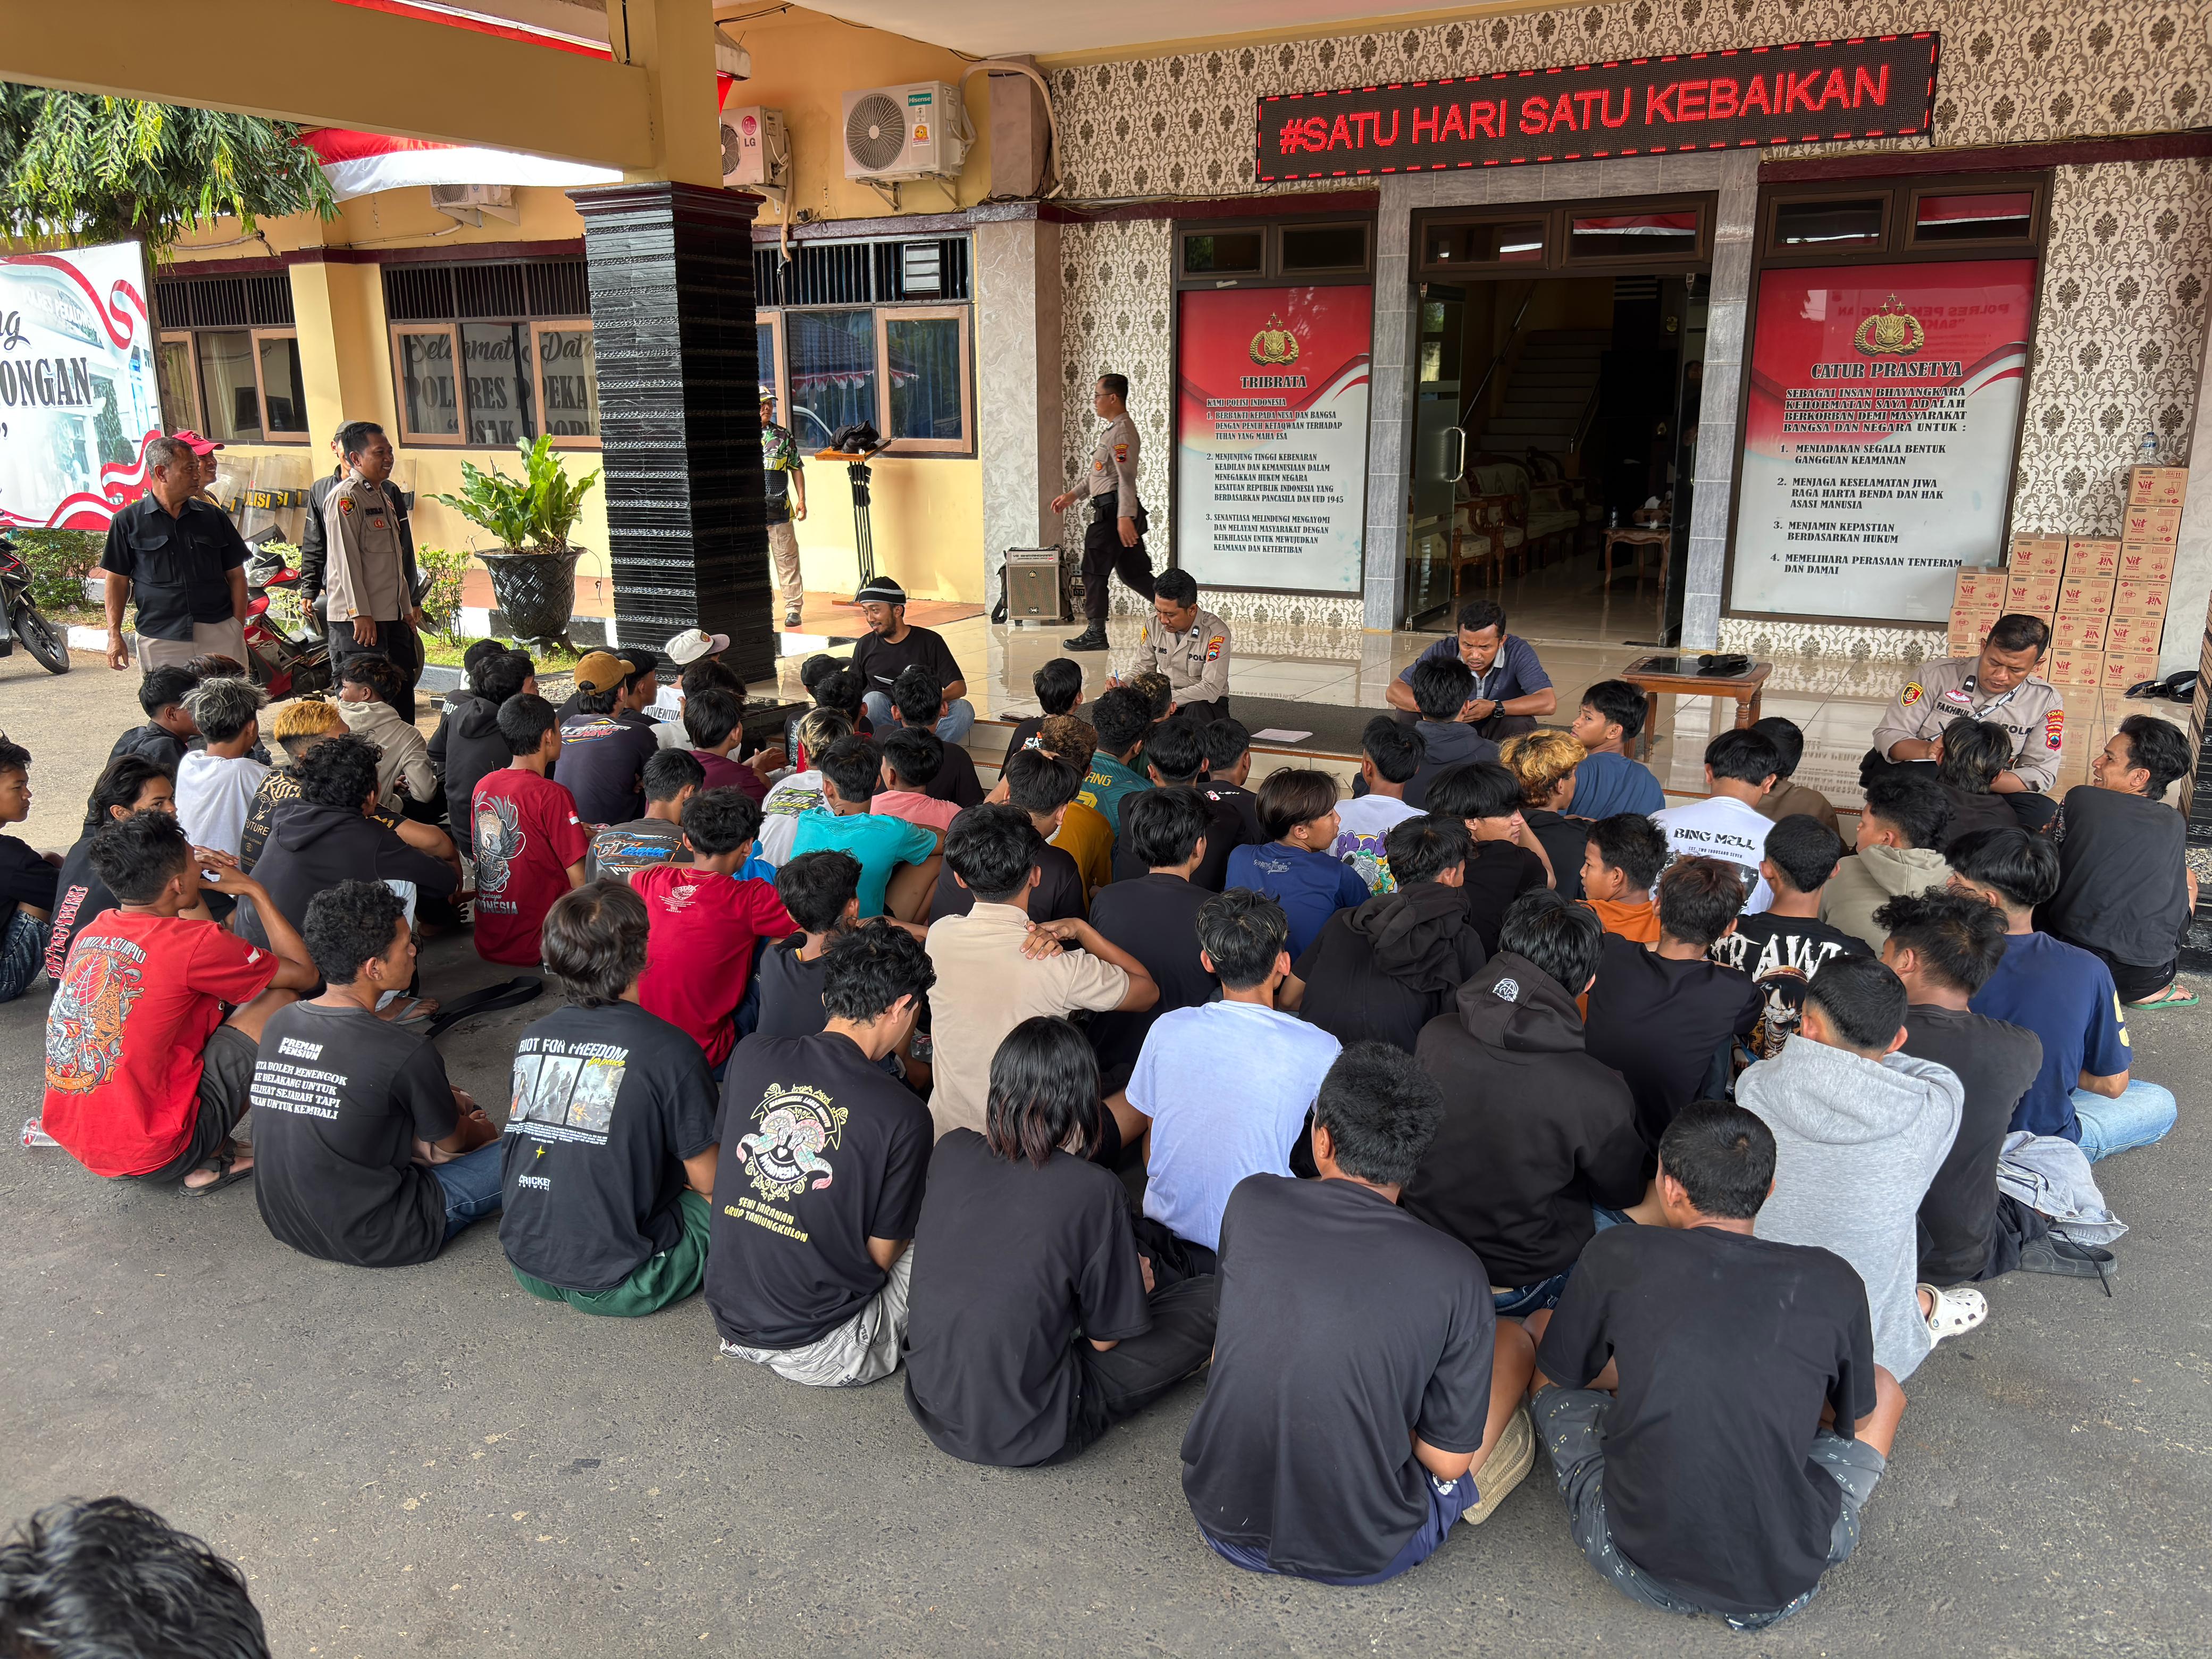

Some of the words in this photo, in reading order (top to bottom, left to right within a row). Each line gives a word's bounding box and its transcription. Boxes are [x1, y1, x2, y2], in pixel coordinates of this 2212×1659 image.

[1279, 107, 1399, 154] #SATU
[1411, 98, 1508, 145] HARI
[1519, 87, 1631, 135] SATU
[1644, 63, 1889, 126] KEBAIKAN
[744, 138, 756, 147] LG
[1811, 364, 1866, 379] CATUR
[1870, 361, 1963, 378] PRASETYA
[1241, 376, 1307, 388] TRIBRATA
[1786, 389, 1836, 398] SEBAGAI
[1838, 389, 1872, 397] INSAN
[1875, 388, 1966, 397] BHAYANGKARA
[1785, 399, 1872, 409] KEHORMATAN
[1876, 399, 1906, 409] SAYA
[1910, 399, 1966, 409] ADALAH
[1784, 411, 1855, 421] BERKORBAN
[1858, 411, 1887, 421] DEMI
[1890, 411, 1967, 421] MASYARAKAT
[1782, 423, 1830, 432] BANGSA
[1833, 423, 1858, 432] DAN
[1862, 423, 1913, 432] NEGARA
[1916, 422, 1957, 432] UNTUK
[1780, 445, 1789, 454] 1.
[1796, 445, 1861, 454] MENIADAKAN
[1863, 445, 1901, 454] SEGALA
[1904, 445, 1946, 454] BENTUK
[1795, 456, 1848, 465] GANGGUAN
[1851, 456, 1906, 465] KEAMANAN
[1777, 477, 1787, 487] 2.
[1792, 477, 1837, 487] MENJAGA
[1839, 478, 1909, 488] KESELAMATAN
[1912, 479, 1937, 488] JIWA
[2138, 480, 2154, 489] Vit
[1791, 489, 1820, 498] RAGA
[1822, 489, 1856, 499] HARTA
[1859, 489, 1894, 499] BENDA
[1896, 490, 1918, 499] DAN
[1921, 490, 1944, 500] HAK
[1790, 499, 1818, 509] ASASI
[1820, 500, 1863, 509] MANUSIA
[1773, 521, 1782, 530] 3.
[1788, 522, 1836, 531] MENJAMIN
[1839, 522, 1895, 532] KEPASTIAN
[2131, 518, 2147, 527] Vit
[1787, 532, 1859, 543] BERDASARKAN
[1863, 533, 1899, 543] HUKUM
[1262, 545, 1302, 554] KETERTIBAN
[2017, 551, 2033, 560] Vit
[2126, 556, 2142, 565] Vit
[1770, 554, 1779, 563] 4.
[1785, 554, 1848, 565] MEMELIHARA
[1851, 556, 1905, 566] PERASAAN
[1907, 558, 1962, 568] TENTERAM
[2097, 557, 2113, 566] Vit
[1784, 564, 1804, 574] DAN
[1807, 564, 1839, 575] DAMAI
[1961, 585, 1976, 594] Vit
[2066, 589, 2082, 598] Vit
[2146, 596, 2161, 606] Vit
[2114, 628, 2129, 638] Vit
[2056, 660, 2072, 670] Vit
[1674, 828, 1711, 841] BING
[1714, 834, 1755, 850] MELL
[281, 1037, 323, 1053] PREMAN
[518, 1038, 540, 1053] RIOT
[542, 1038, 565, 1053] FOR
[278, 1045, 320, 1060] PENSIUN
[598, 1058, 626, 1068] peace
[268, 1062, 295, 1075] BOLEH
[294, 1067, 348, 1086] MENENGOK
[301, 1081, 338, 1095] UNTUK
[275, 1087, 314, 1102] SEJARAH
[315, 1095, 341, 1108] TAPI
[267, 1099, 294, 1112] UNTUK
[518, 1175, 551, 1186] CRICKET
[739, 1197, 757, 1210] SENI
[756, 1202, 794, 1225] JARANAN
[724, 1205, 744, 1218] GRUP
[745, 1211, 808, 1243] TANJUNGKULON
